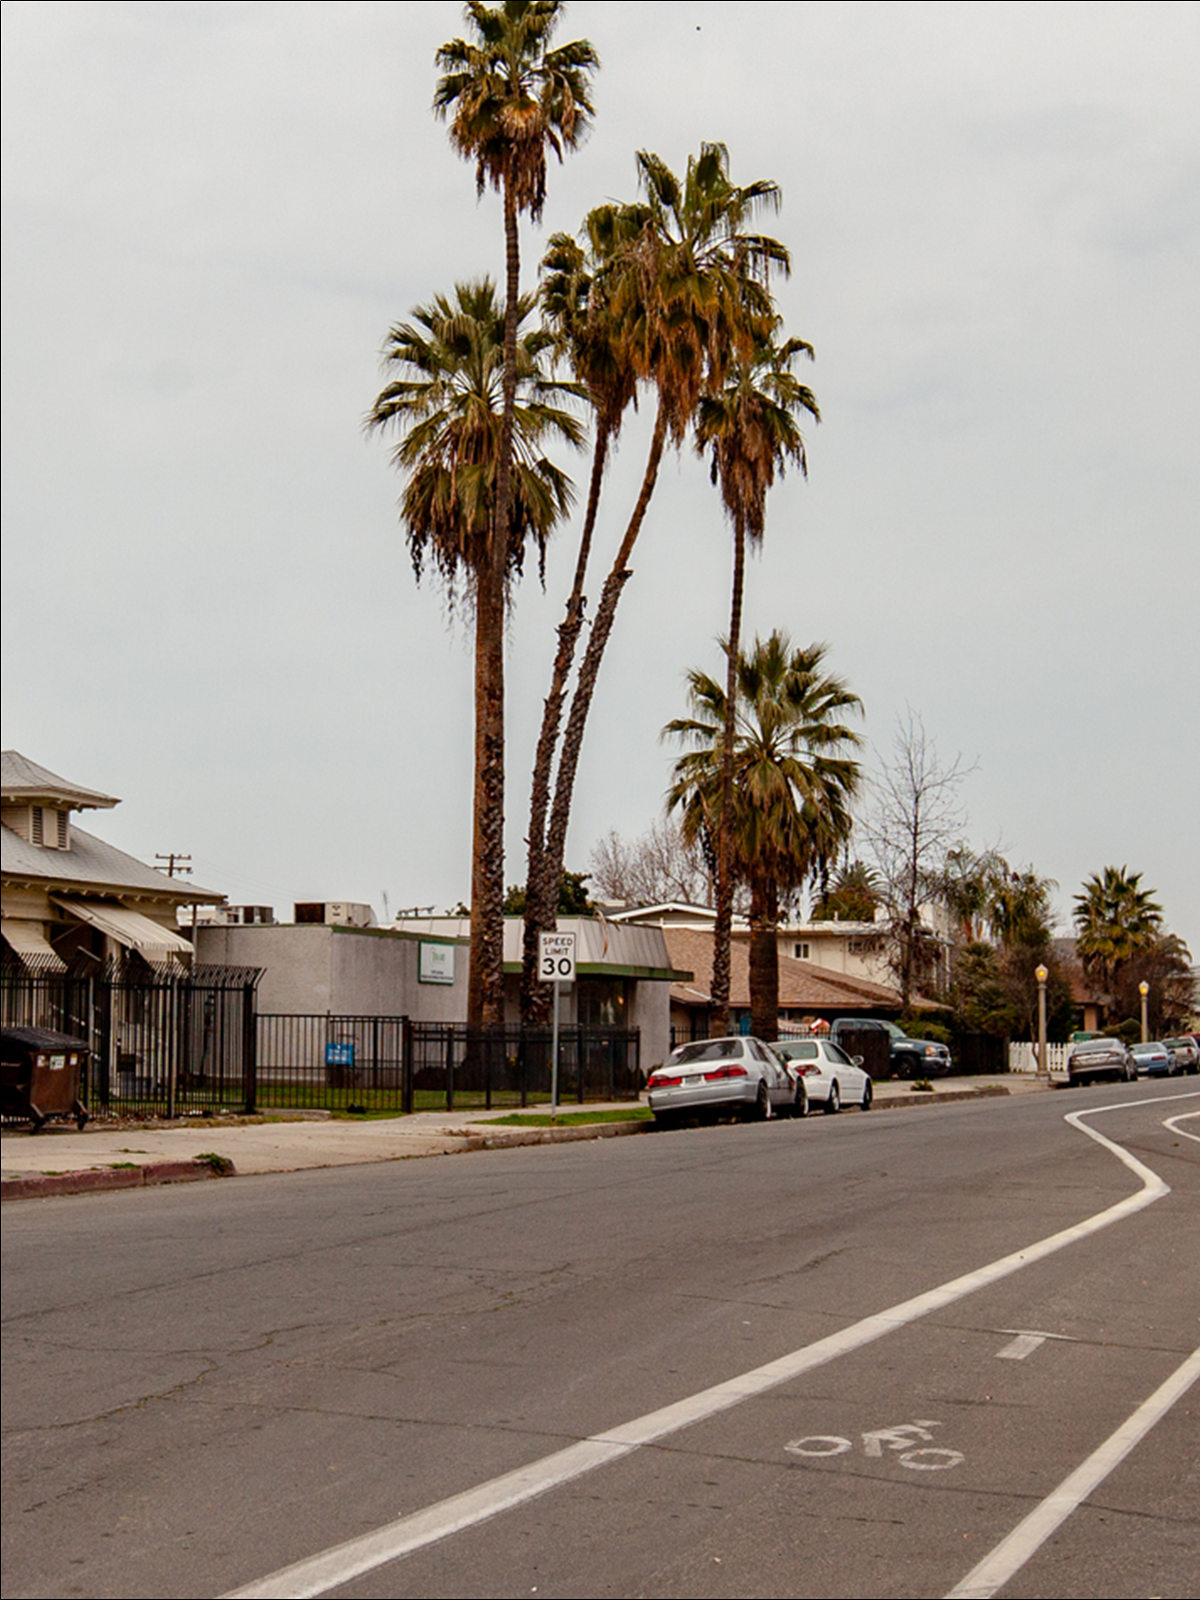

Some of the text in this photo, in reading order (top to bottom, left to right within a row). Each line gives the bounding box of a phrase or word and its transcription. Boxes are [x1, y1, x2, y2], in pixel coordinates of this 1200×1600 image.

[542, 937, 573, 946] SPEED
[545, 947, 569, 955] LIMIT
[542, 957, 571, 975] 30
